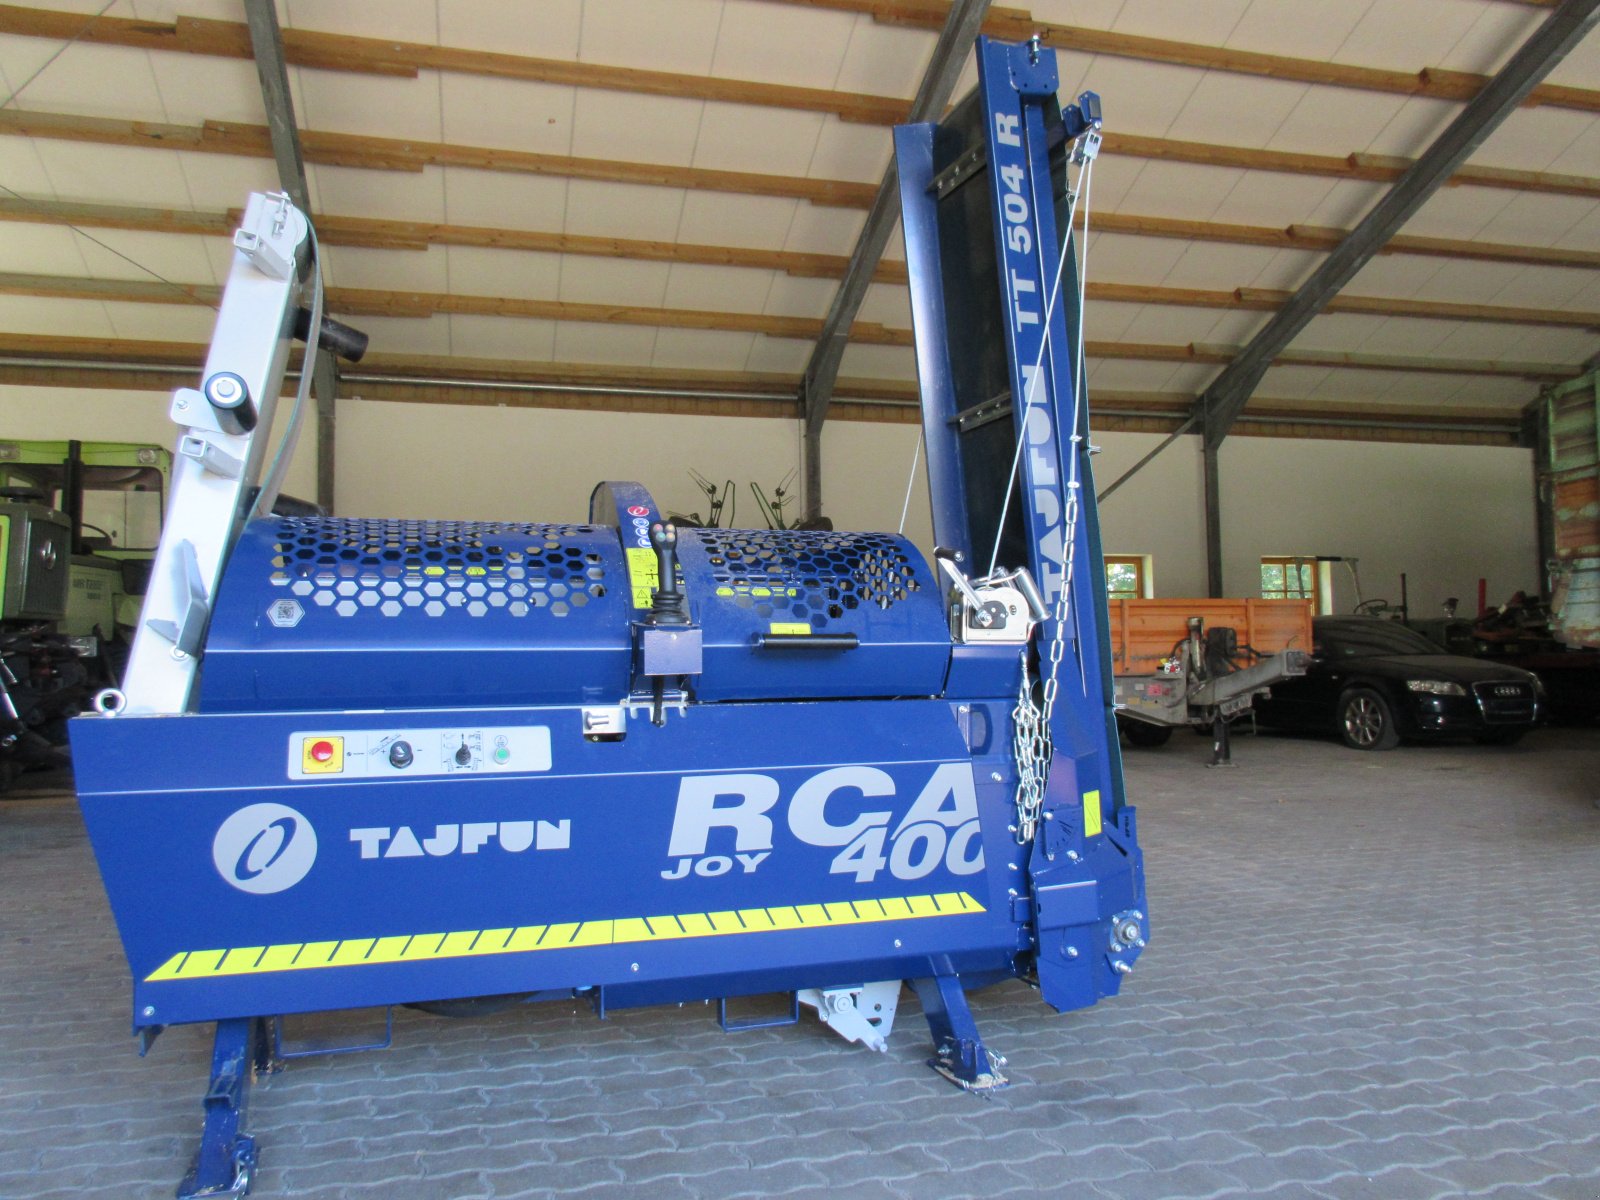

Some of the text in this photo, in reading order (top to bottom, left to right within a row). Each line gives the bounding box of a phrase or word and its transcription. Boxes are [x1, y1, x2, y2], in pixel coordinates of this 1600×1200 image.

[995, 112, 1065, 604] TAJFUN TT 504 R
[349, 819, 571, 859] TAJFUN
[667, 762, 980, 857] RCA
[660, 852, 772, 880] JOY
[829, 820, 986, 883] 400
